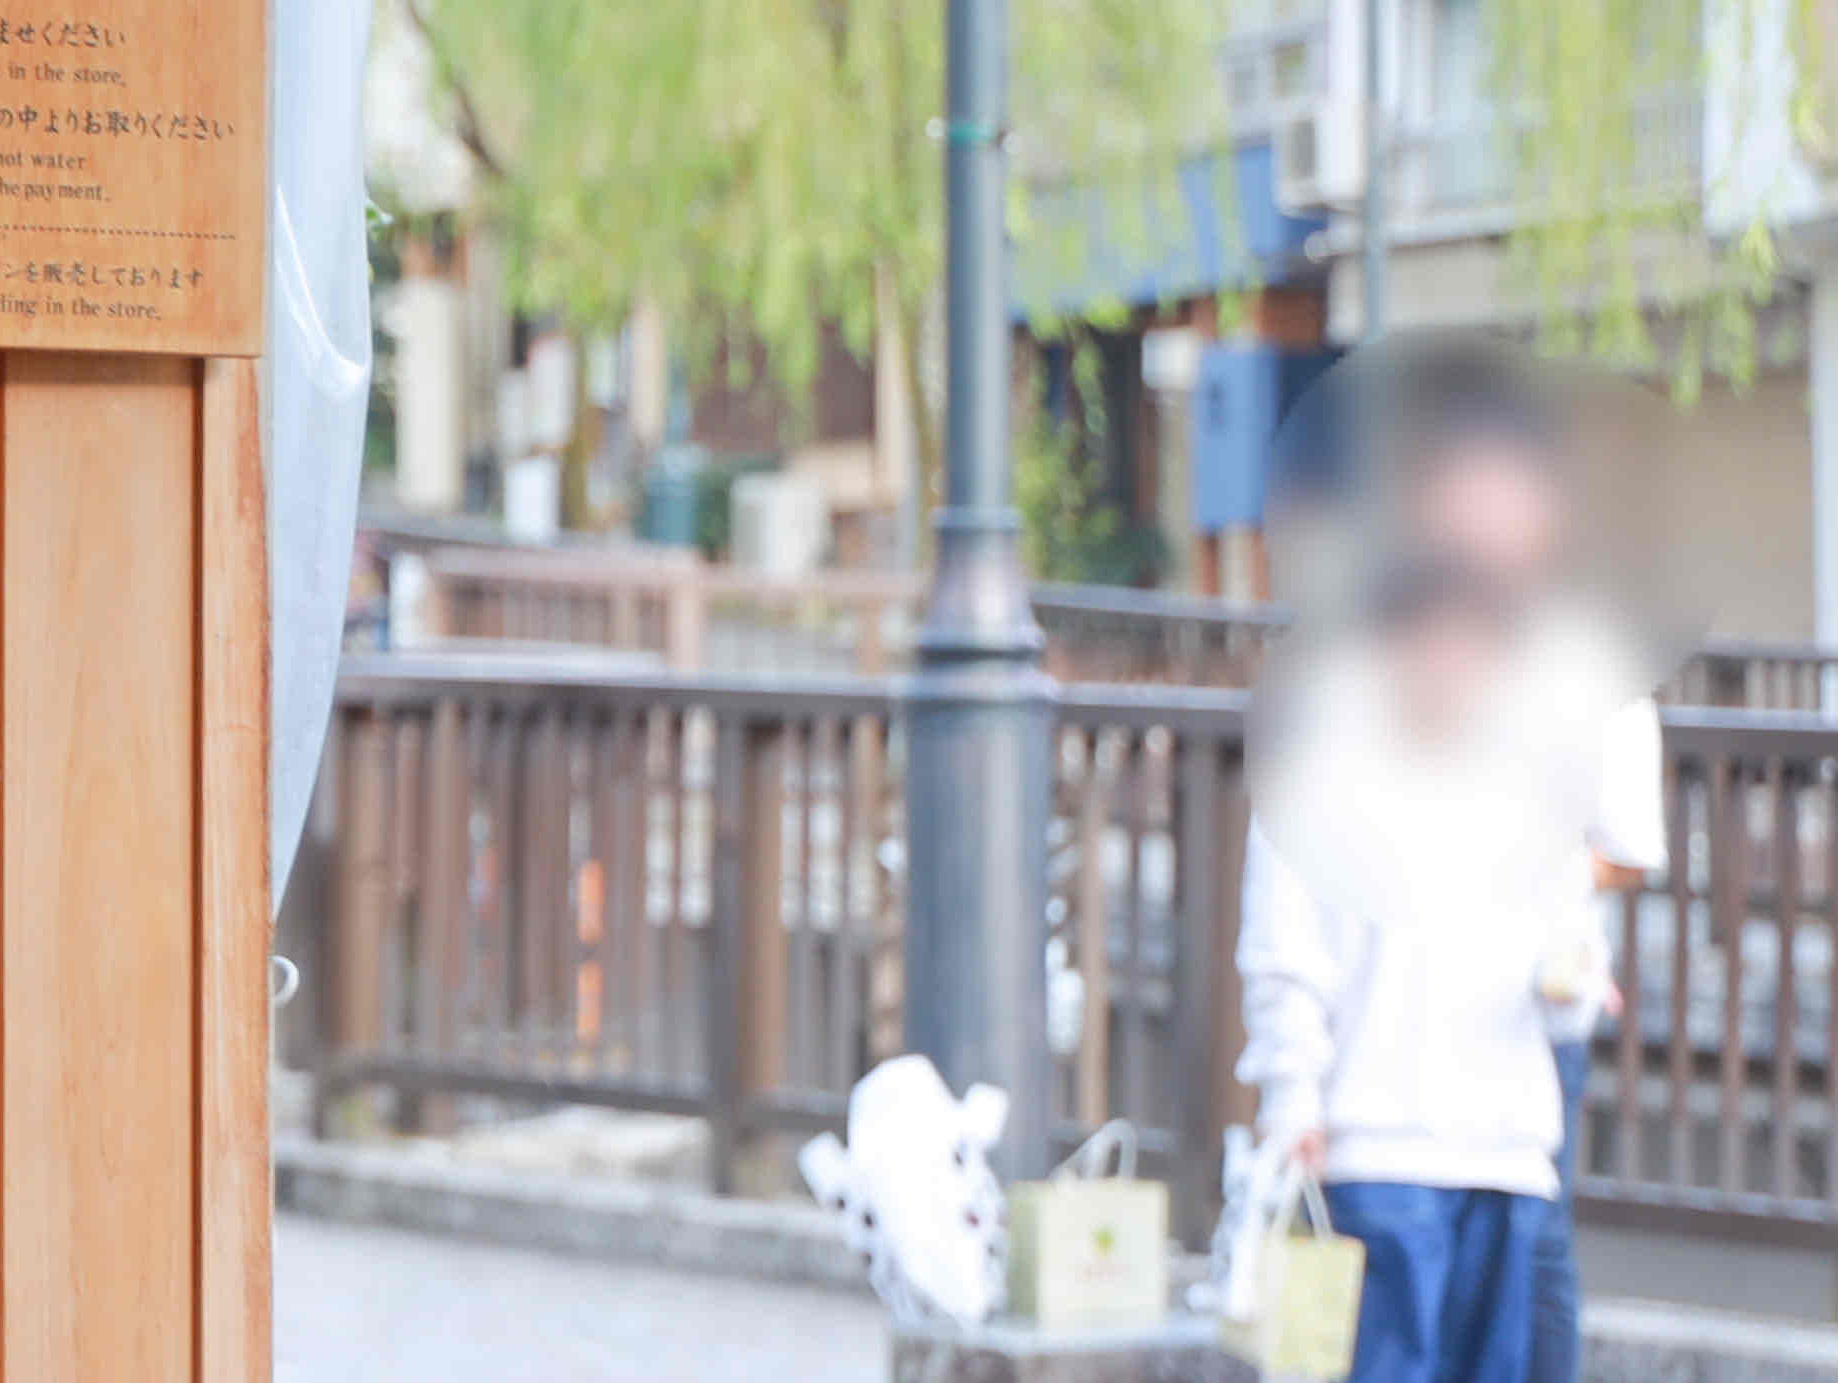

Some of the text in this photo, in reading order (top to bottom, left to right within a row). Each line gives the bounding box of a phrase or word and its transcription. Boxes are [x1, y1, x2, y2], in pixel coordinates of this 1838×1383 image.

[10, 62, 26, 80] in
[35, 62, 65, 82] the
[31, 152, 86, 170] water
[46, 296, 64, 315] in
[72, 298, 101, 318] the
